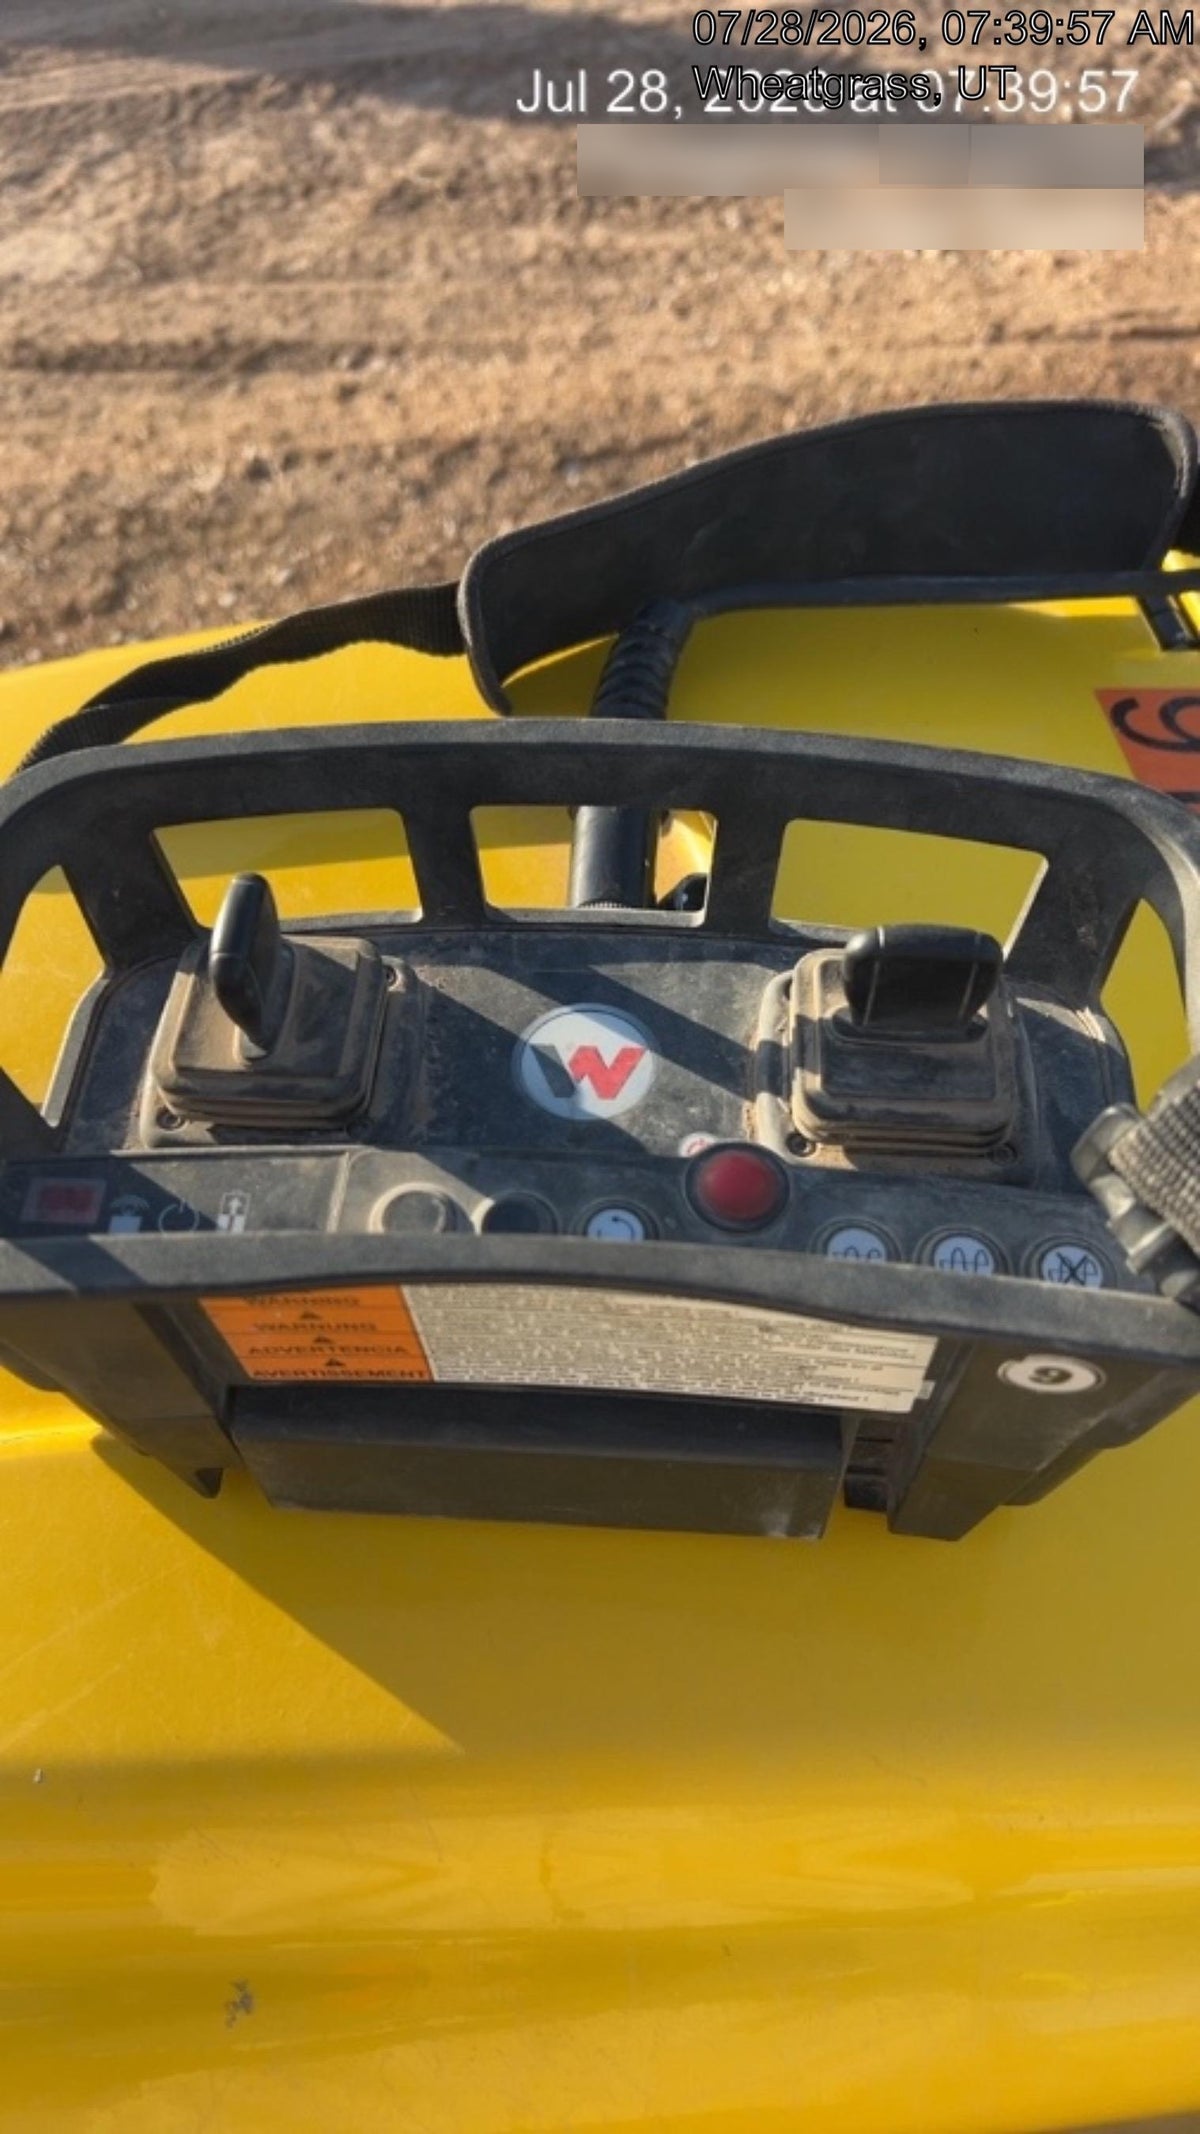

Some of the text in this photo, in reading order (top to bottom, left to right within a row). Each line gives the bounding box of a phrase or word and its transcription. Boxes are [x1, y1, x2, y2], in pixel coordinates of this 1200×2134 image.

[243, 1293, 361, 1307] WARNING
[248, 1344, 408, 1356] ADVERTENCIA
[252, 1367, 429, 1379] AVERTISSEMENT
